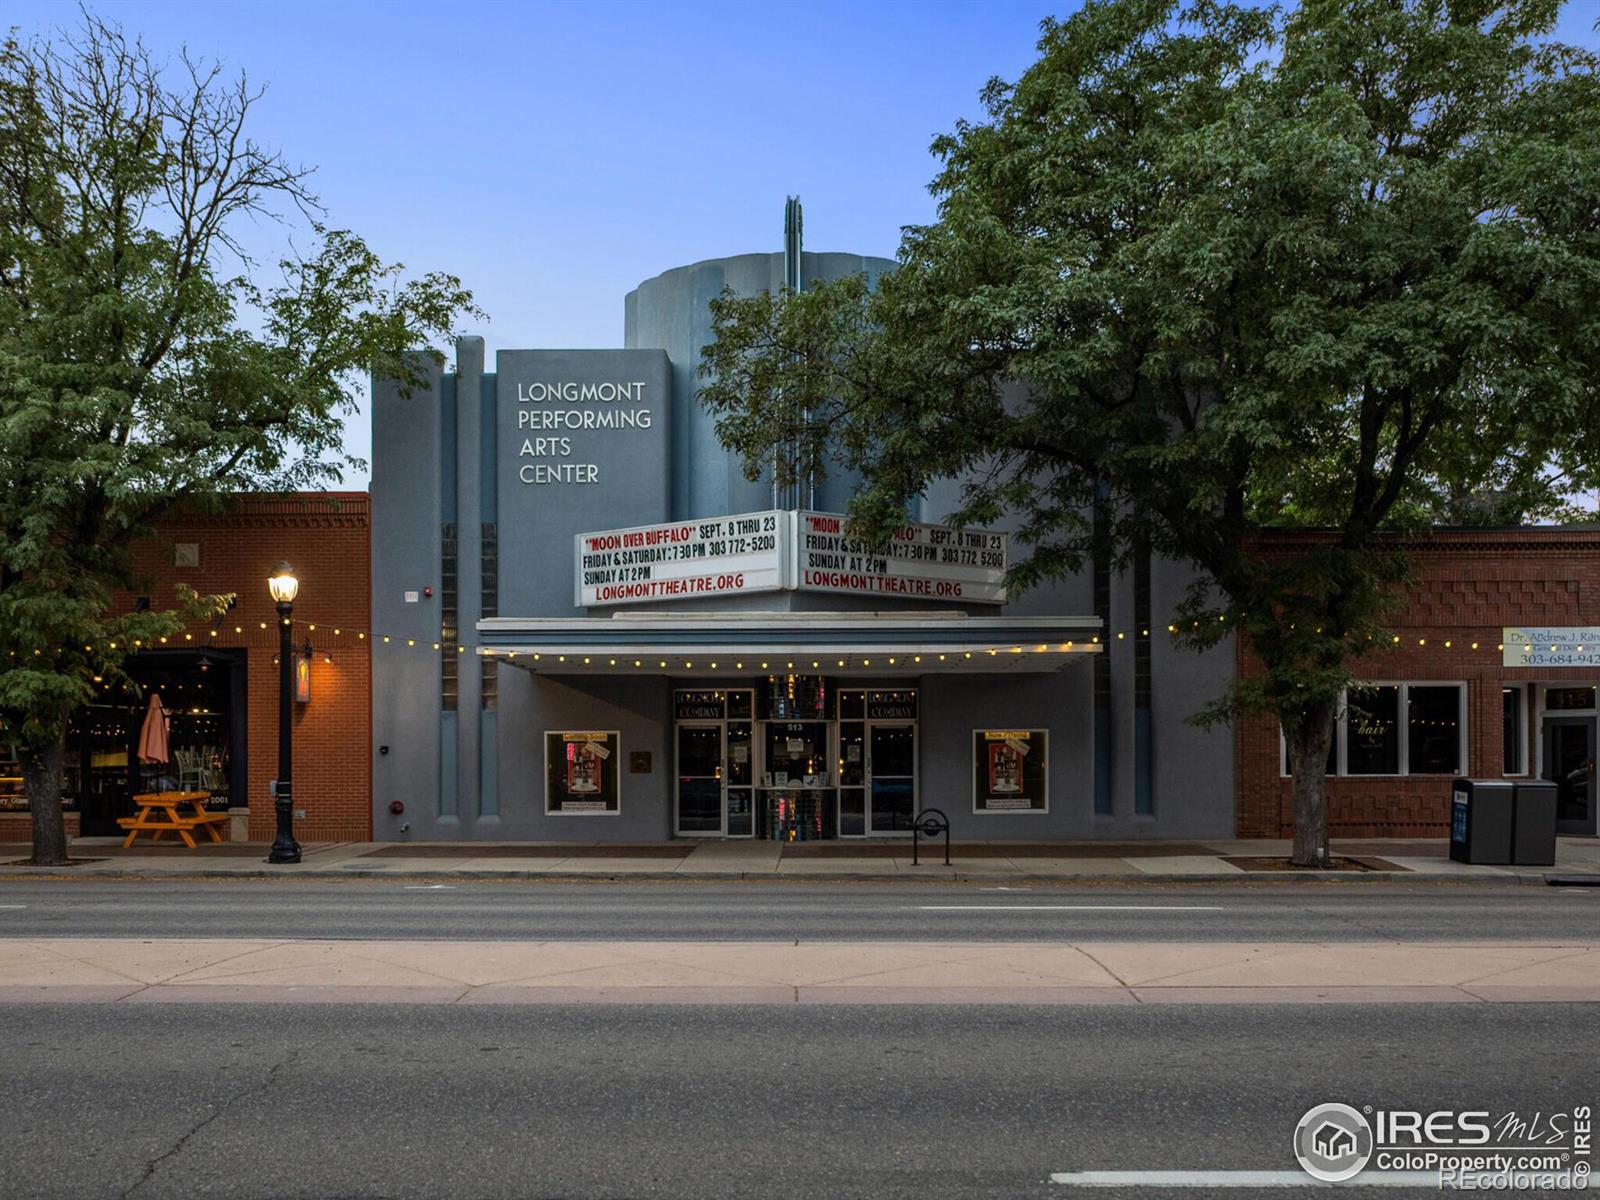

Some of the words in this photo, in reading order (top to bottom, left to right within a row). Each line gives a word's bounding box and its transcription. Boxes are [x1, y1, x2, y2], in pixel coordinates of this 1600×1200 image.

[517, 382, 646, 402] LONGMONT
[518, 409, 652, 429] PERFORMING
[519, 437, 571, 456] ARTS
[519, 464, 599, 483] CENTER
[623, 534, 644, 549] OVER
[699, 524, 726, 540] SEPT.
[728, 522, 735, 536] 8
[737, 519, 760, 535] THRU
[763, 516, 776, 532] 23
[930, 529, 956, 546] SEPT.
[957, 532, 963, 546] 8
[964, 533, 987, 549] THRU
[990, 536, 1001, 550] 23
[583, 552, 612, 569] FRIDAY
[709, 541, 727, 556] 303
[806, 535, 840, 552] FRIDAY
[942, 548, 959, 563] 303
[960, 550, 977, 565] 772
[981, 552, 1003, 568] 5200
[808, 553, 846, 570] SUNDAY
[850, 556, 862, 572] AT
[584, 570, 617, 585] SUNDAY
[618, 568, 630, 582] AT
[1510, 632, 1527, 642] Dr.
[1571, 632, 1578, 642] J.
[209, 796, 229, 804] 2001
